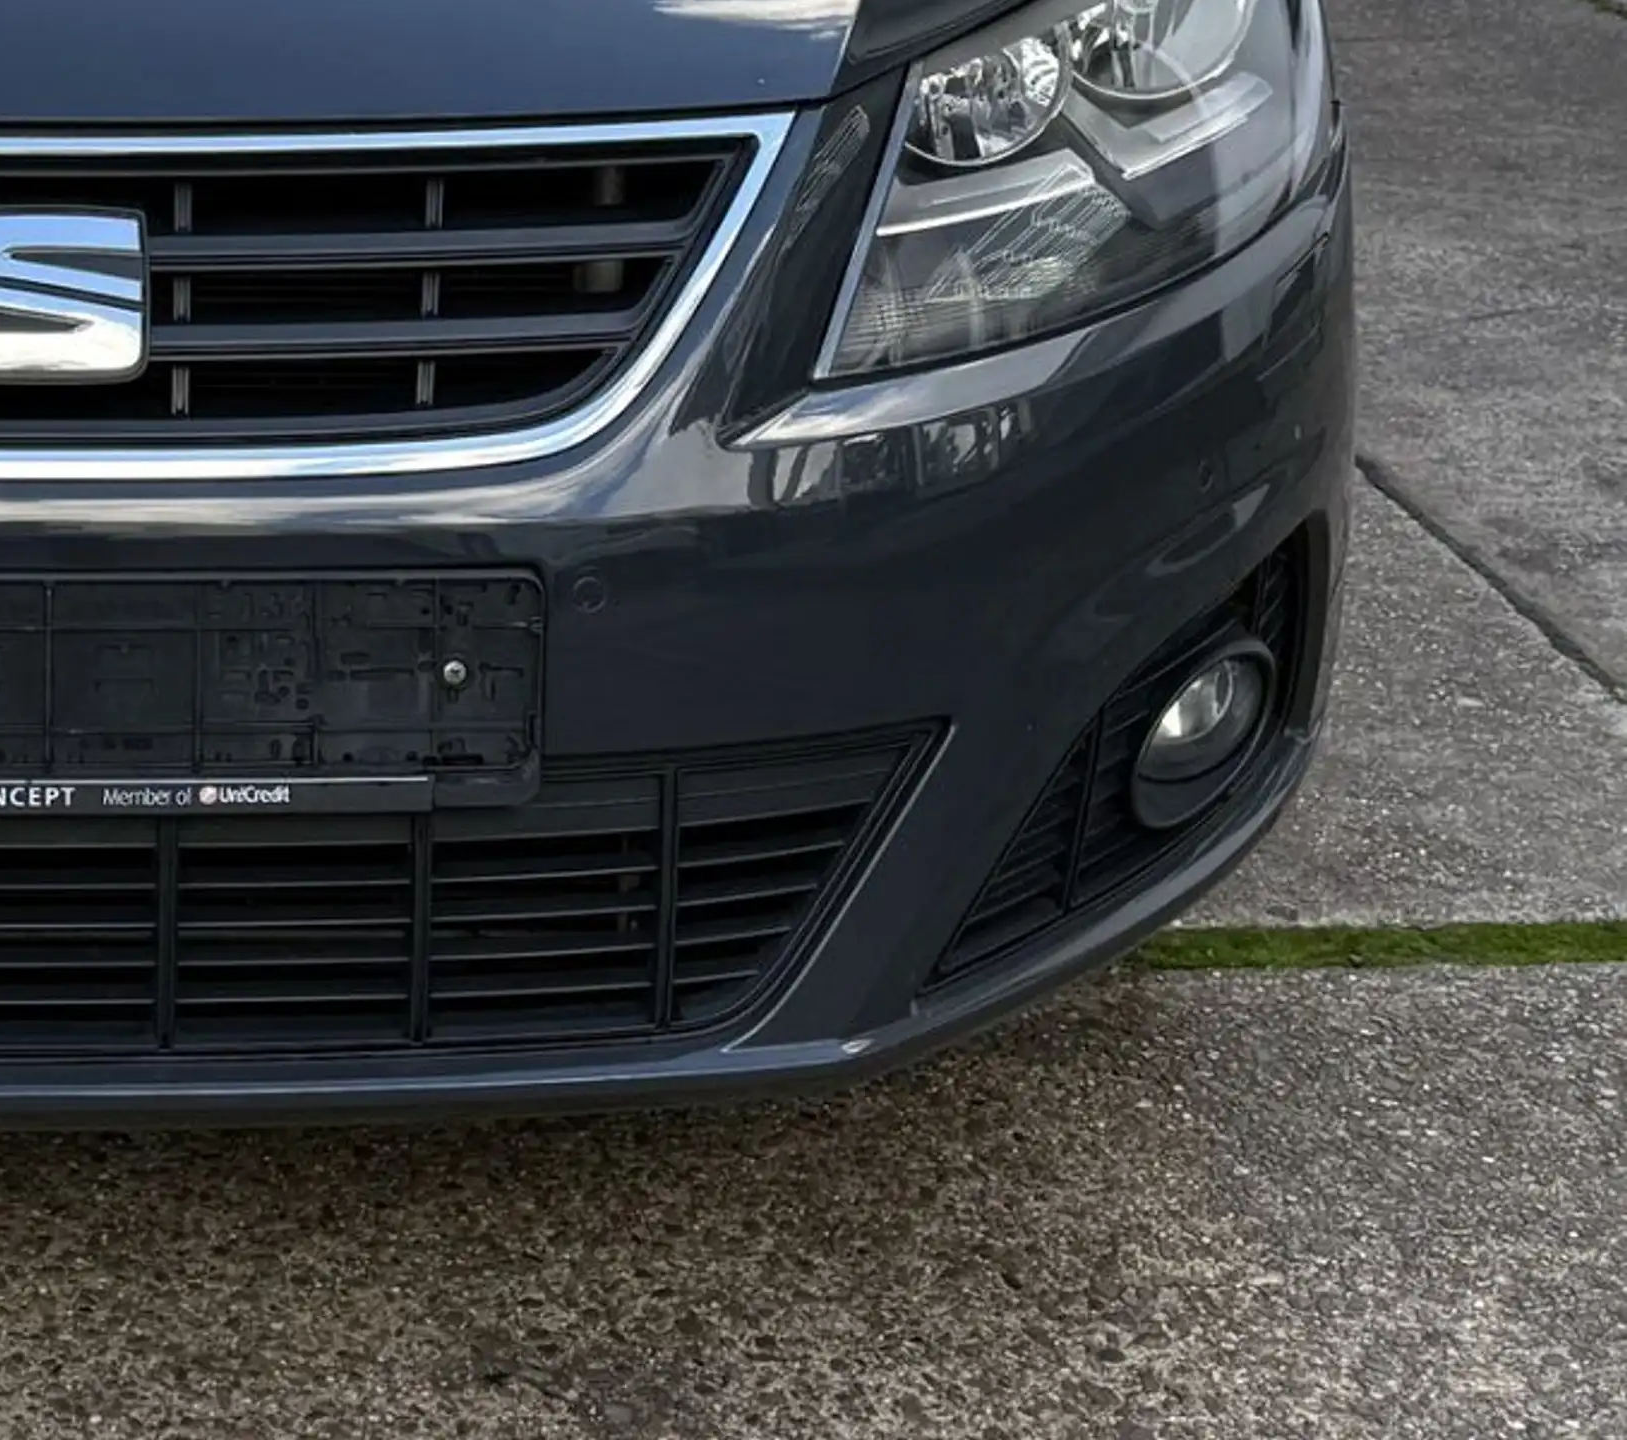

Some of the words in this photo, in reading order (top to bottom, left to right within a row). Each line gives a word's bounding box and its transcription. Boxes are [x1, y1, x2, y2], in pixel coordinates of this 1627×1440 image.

[102, 787, 172, 806] Member
[175, 788, 193, 805] of
[219, 785, 290, 803] UniCredit
